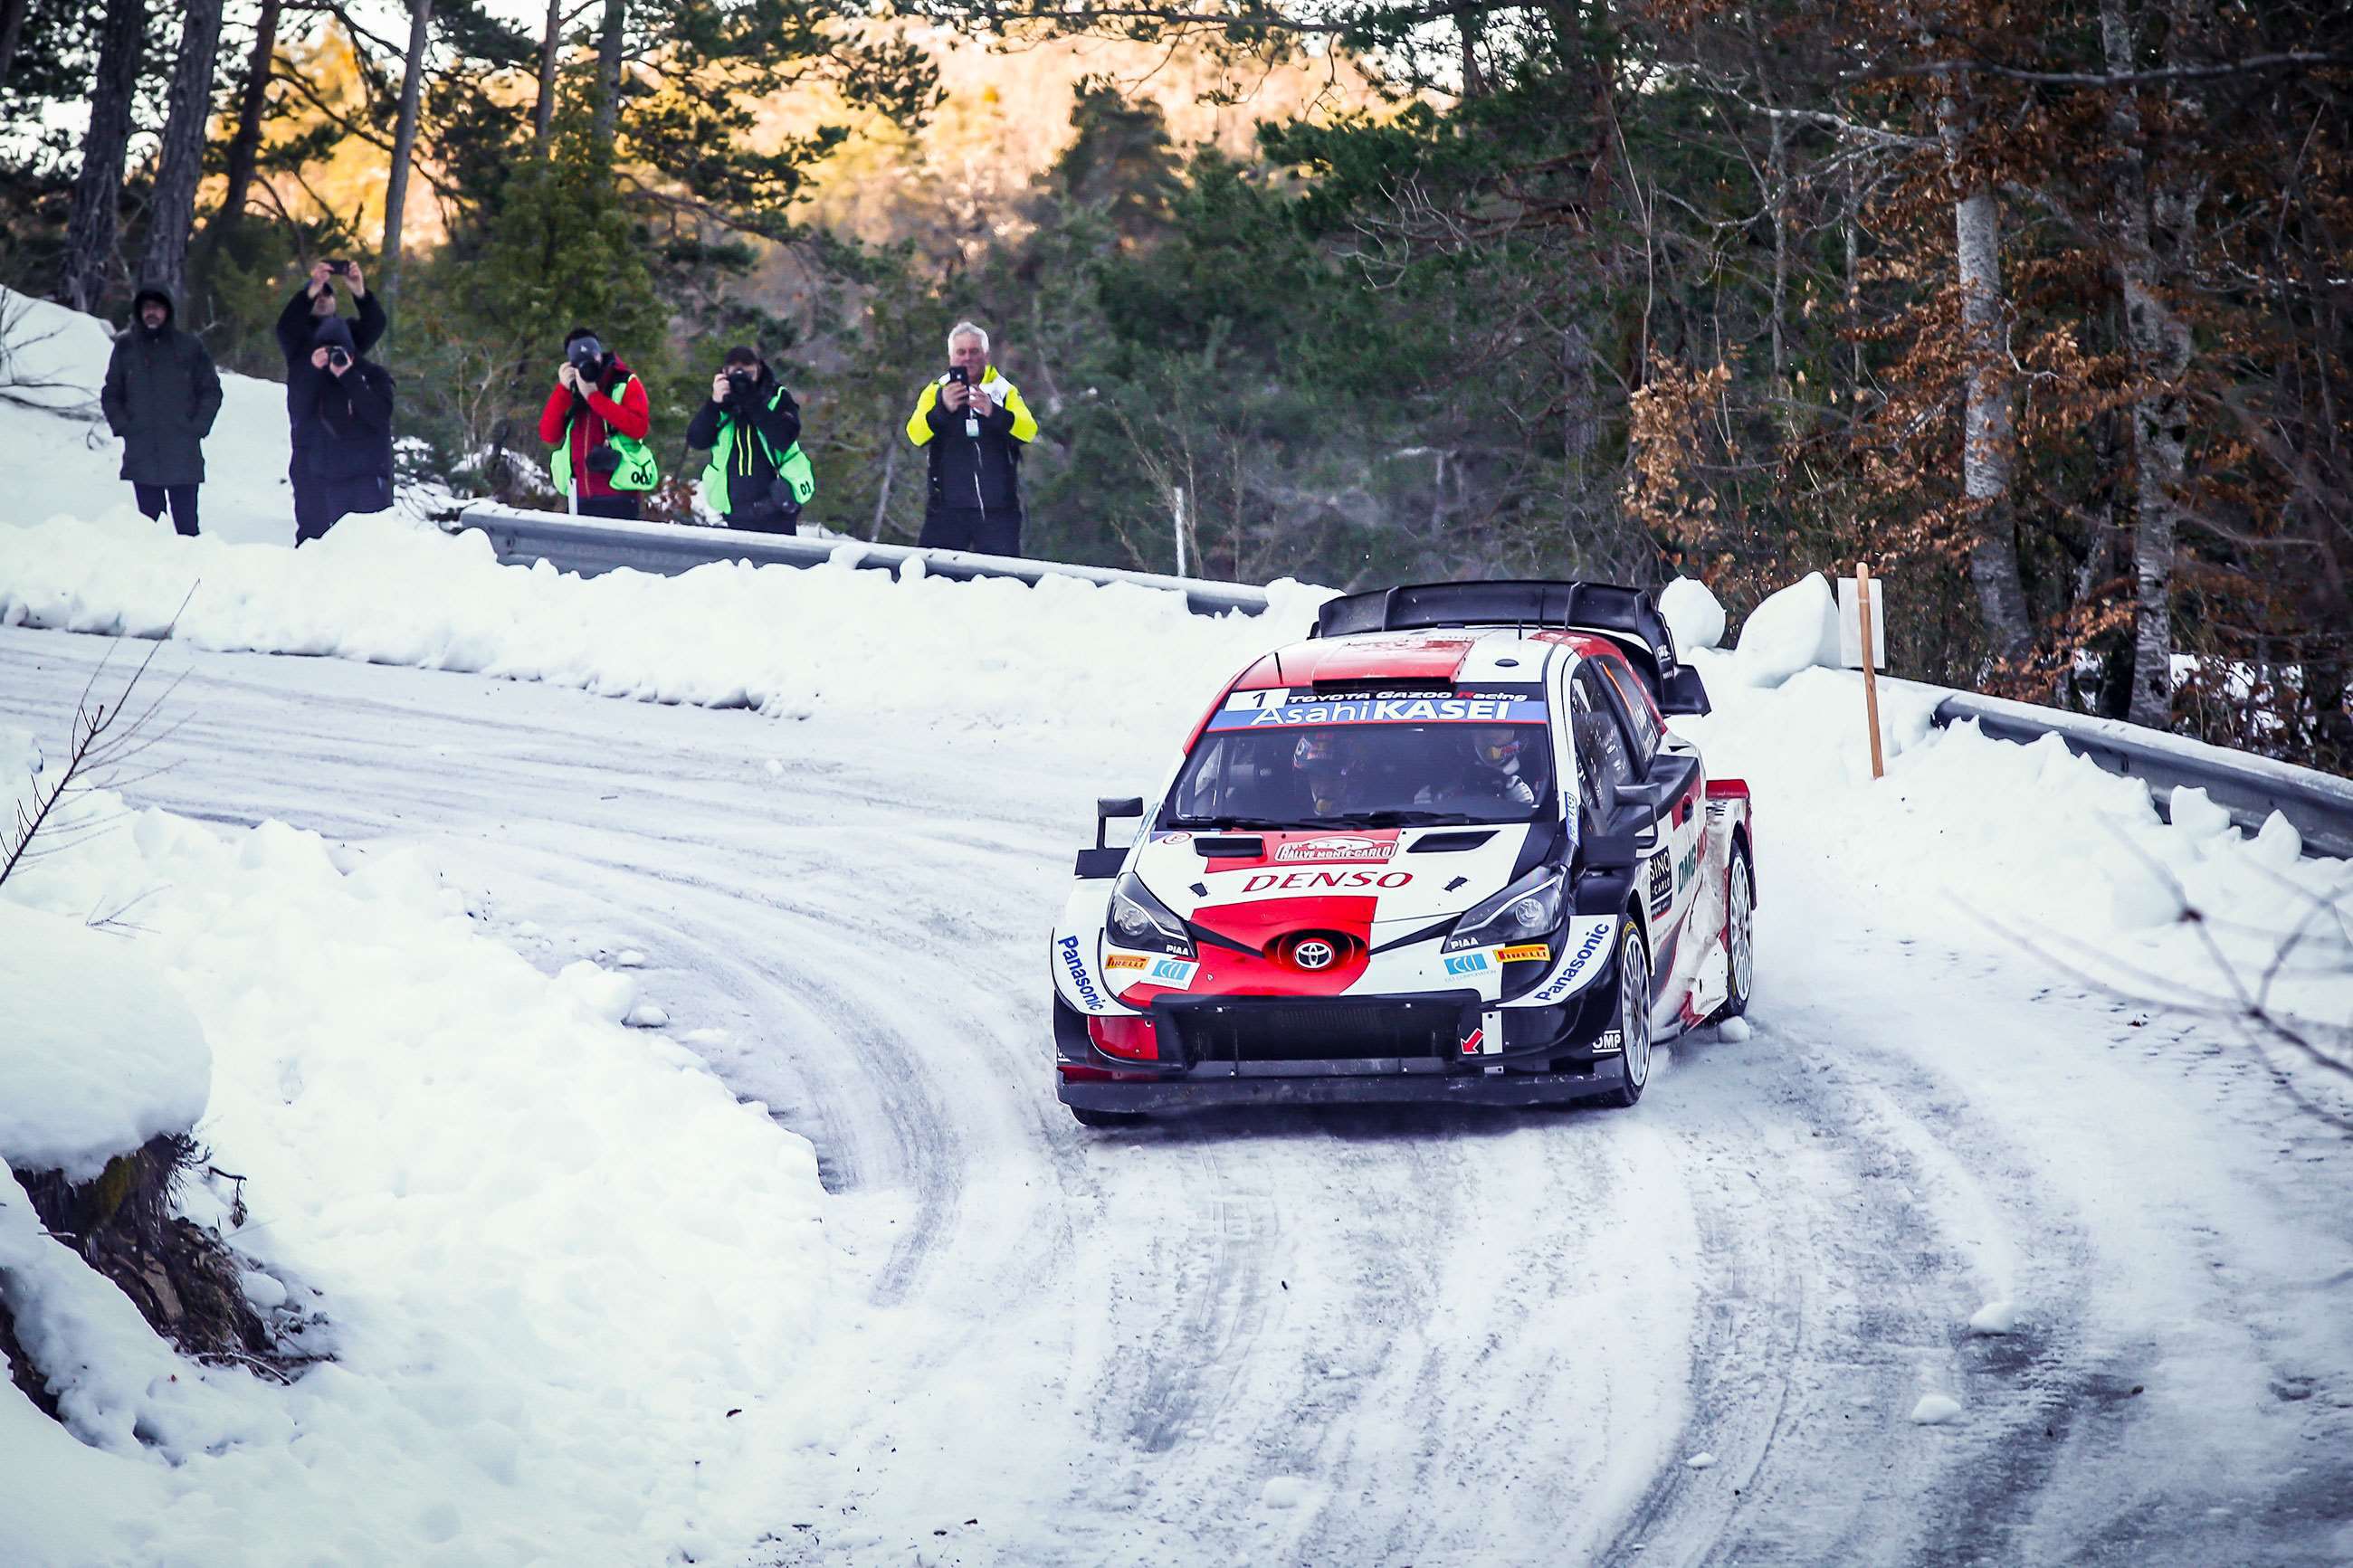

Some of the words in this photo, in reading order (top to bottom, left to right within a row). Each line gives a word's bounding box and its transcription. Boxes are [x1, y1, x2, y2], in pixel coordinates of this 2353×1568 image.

[800, 480, 811, 496] 01
[1253, 691, 1267, 708] 1
[1289, 692, 1370, 704] TOYOTA
[1376, 690, 1453, 699] GAZOO
[1456, 690, 1529, 702] Racing
[1280, 845, 1315, 860] RALLYE
[1242, 871, 1414, 893] DENSO
[1166, 944, 1190, 956] PIAA
[1451, 937, 1480, 949] PIAA
[1106, 955, 1147, 968] PIRELLI
[1534, 923, 1610, 1001] Panasonic
[1057, 935, 1105, 1012] Panasonic
